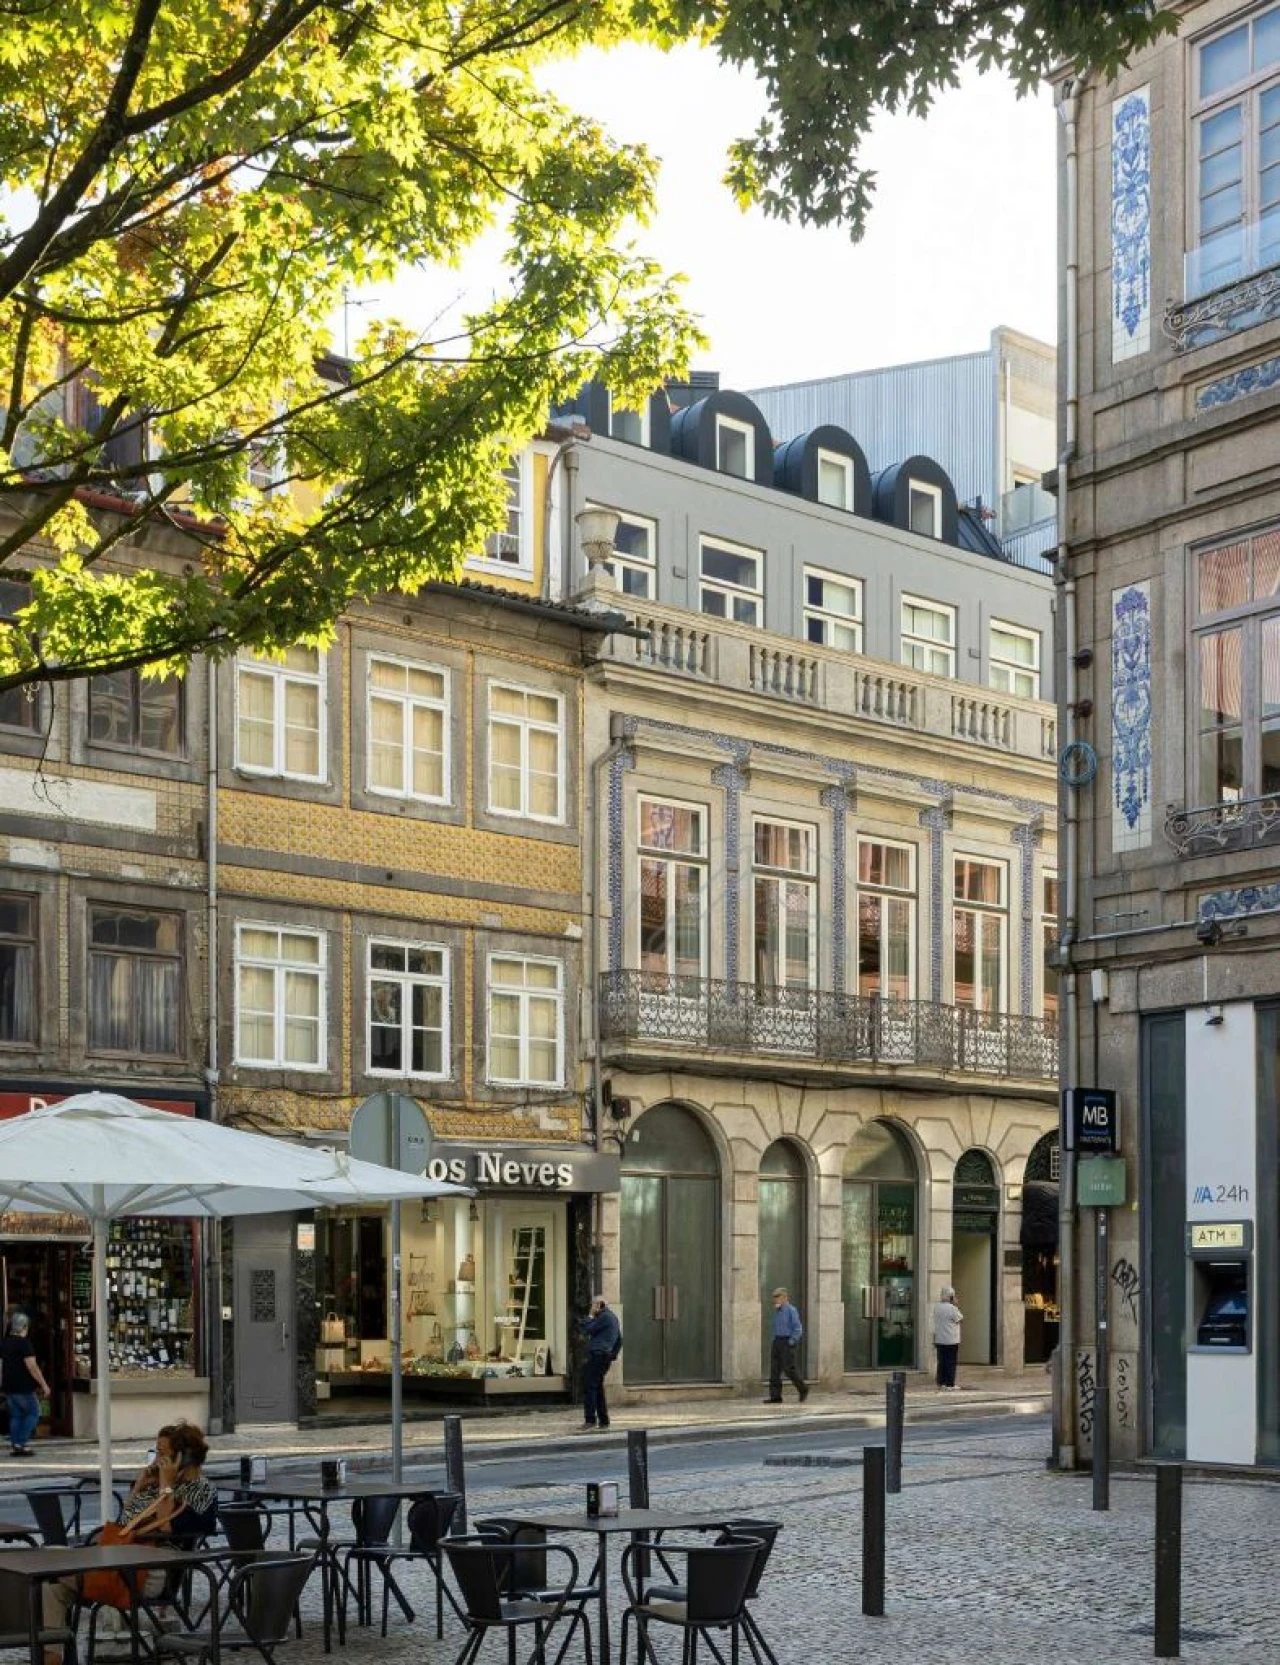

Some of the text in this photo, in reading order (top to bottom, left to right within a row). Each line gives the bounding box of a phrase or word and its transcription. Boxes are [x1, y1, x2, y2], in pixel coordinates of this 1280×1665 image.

[1082, 1105, 1108, 1126] MB
[478, 1151, 573, 1186] Neves
[1216, 1184, 1249, 1203] 24h
[1198, 1229, 1226, 1242] ATM
